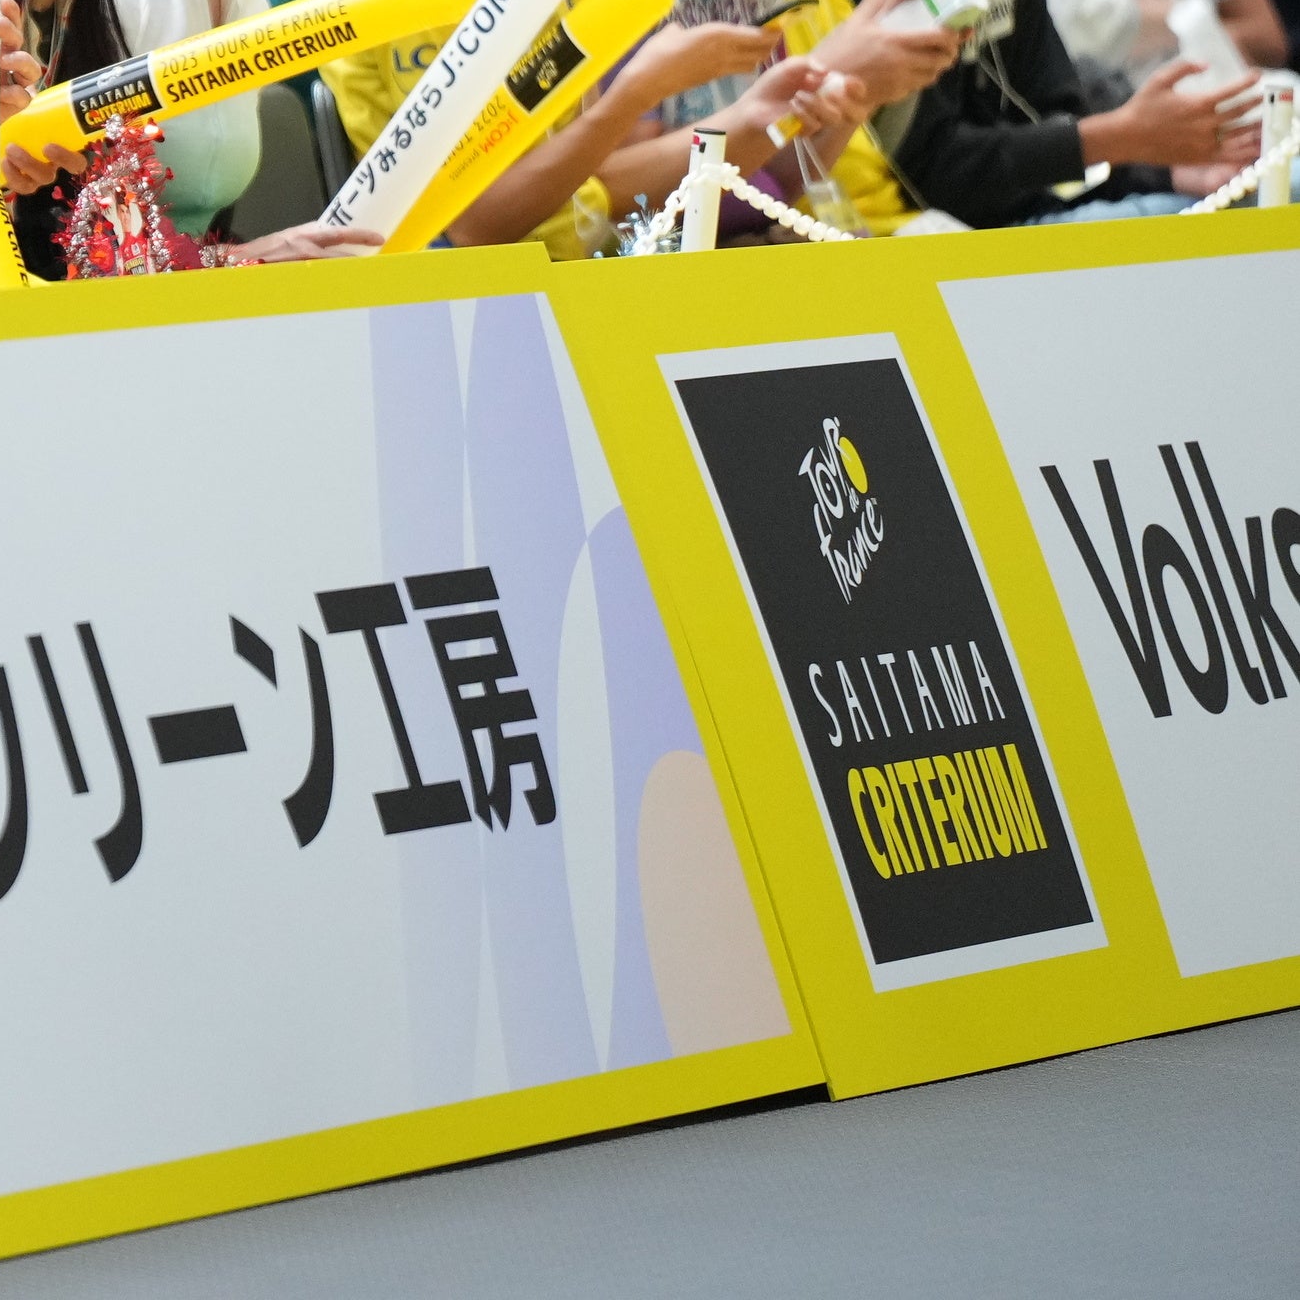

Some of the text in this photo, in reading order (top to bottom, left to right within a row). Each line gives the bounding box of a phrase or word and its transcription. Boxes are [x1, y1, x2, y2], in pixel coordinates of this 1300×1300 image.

[161, 0, 348, 78] 2023 TOUR DE FRANCE
[166, 59, 254, 103] SAITAMA
[254, 21, 358, 73] CRITERIUM
[79, 80, 148, 112] SAITAMA
[808, 640, 1006, 748] SAITAMA
[847, 743, 1049, 881] CRITERIUM
